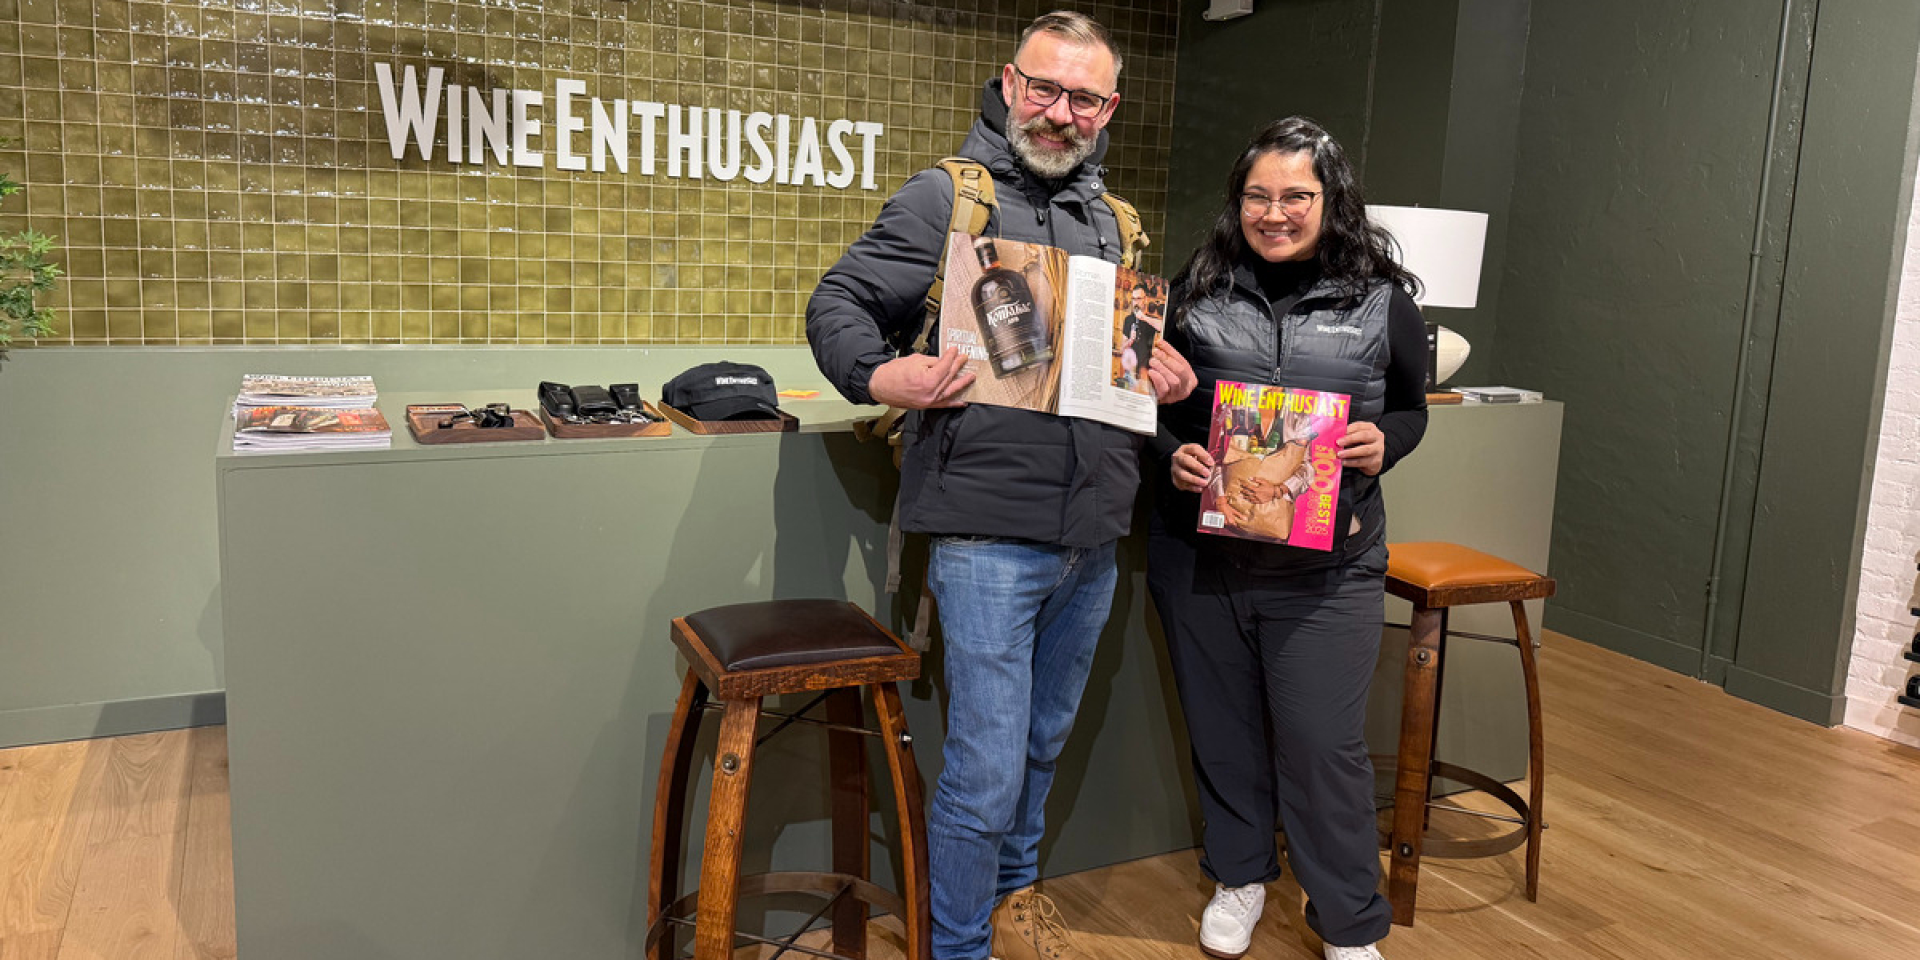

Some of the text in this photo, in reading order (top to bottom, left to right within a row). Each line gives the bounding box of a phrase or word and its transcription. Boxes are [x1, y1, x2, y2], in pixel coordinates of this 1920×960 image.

[374, 62, 884, 190] WINE ENTHUSIAST
[1218, 383, 1348, 419] WINE ENTHUSIAST
[1309, 447, 1337, 493] 100
[1316, 494, 1332, 526] BEST
